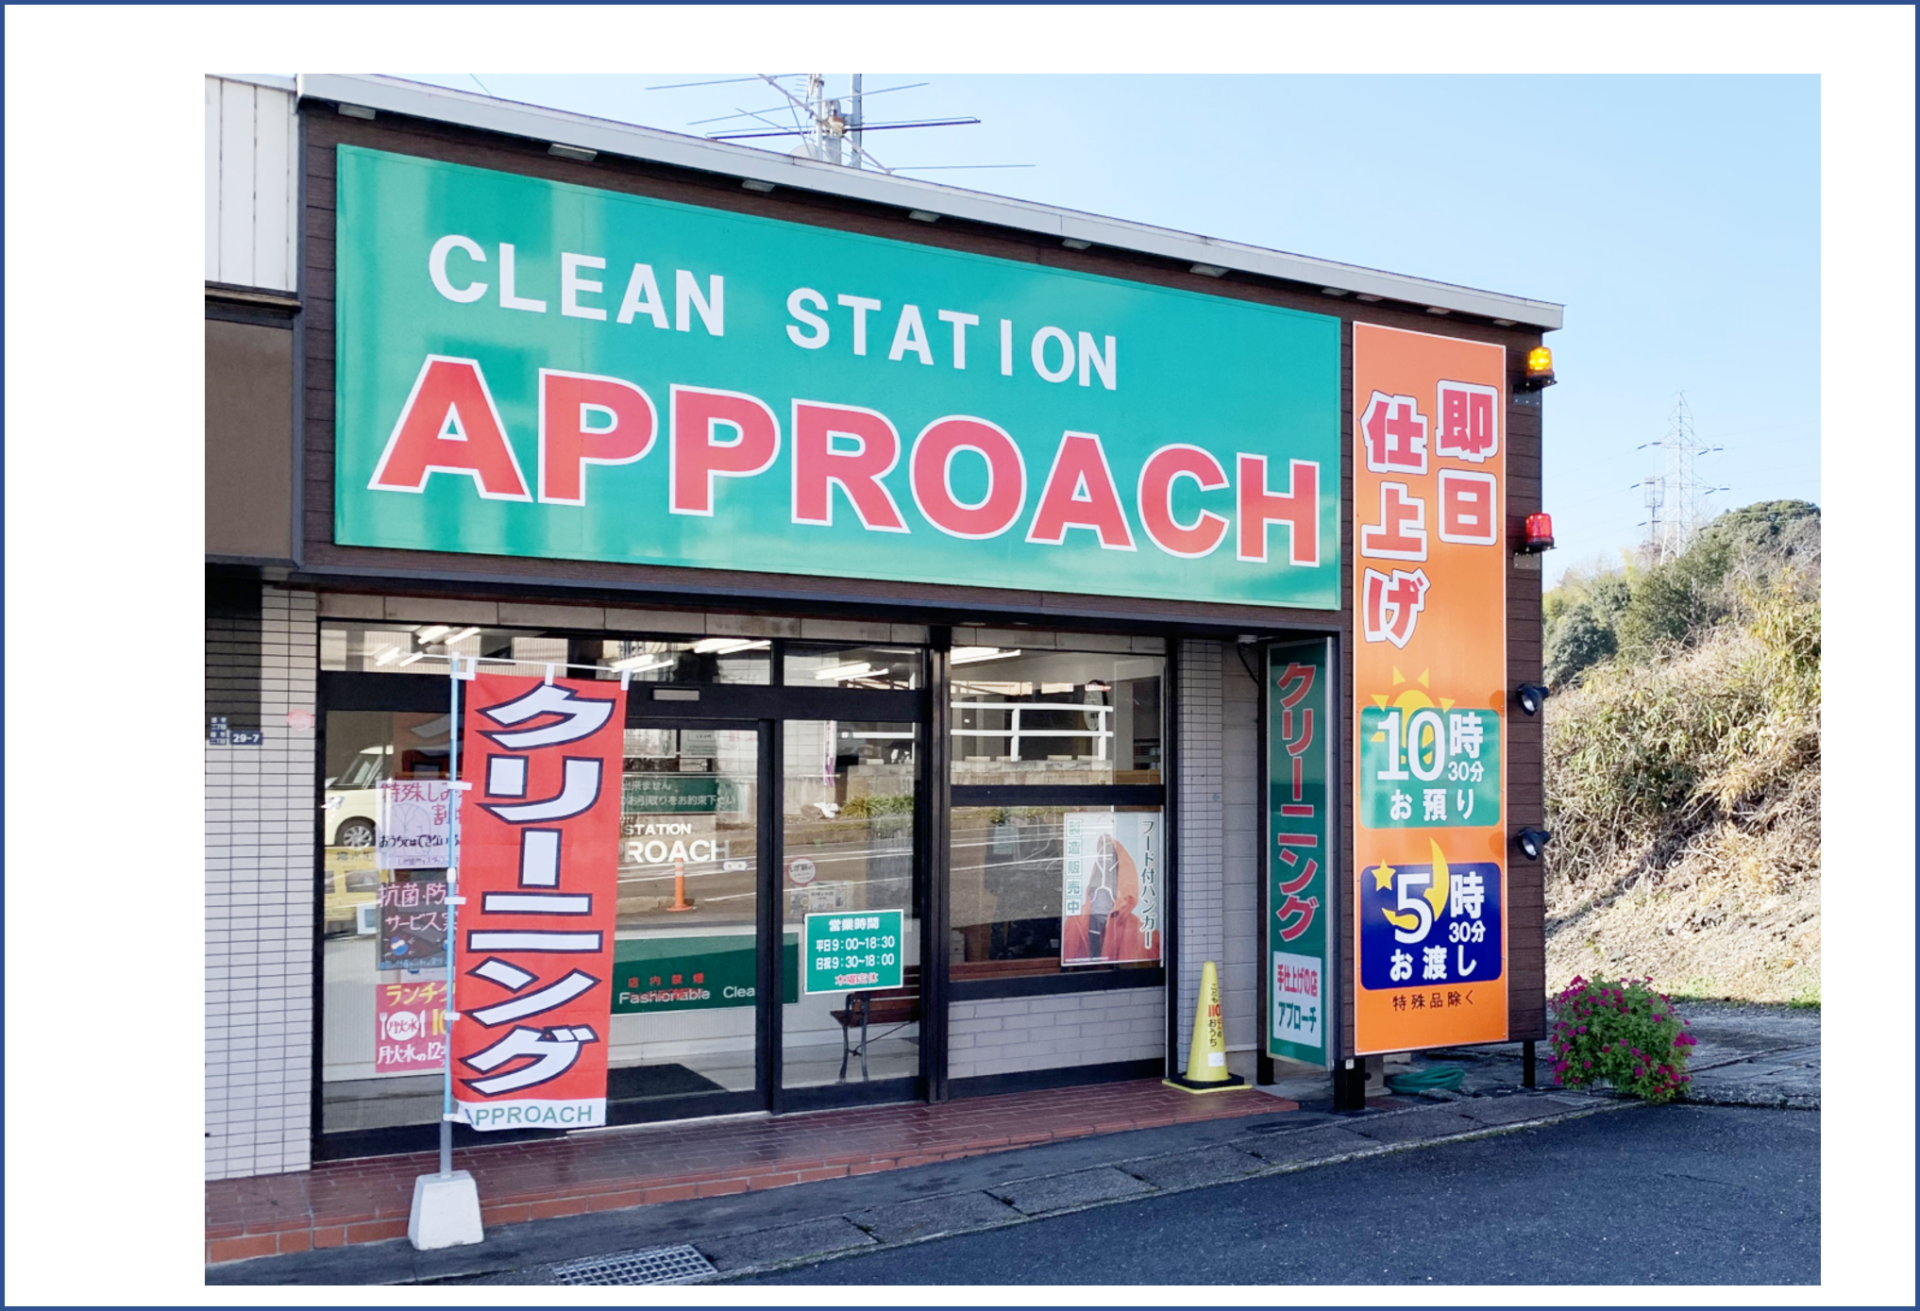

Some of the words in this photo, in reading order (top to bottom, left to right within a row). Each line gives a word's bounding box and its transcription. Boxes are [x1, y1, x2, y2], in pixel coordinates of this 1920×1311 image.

[428, 233, 725, 337] CLEAN
[785, 287, 1117, 390] STATION
[366, 353, 1321, 567] APPROACH
[1435, 379, 1499, 546] 即日
[1359, 389, 1431, 649] 仕上げ
[232, 733, 260, 743] 29-7
[1447, 760, 1486, 783] 30分
[1276, 662, 1320, 942] クリーニング
[1389, 788, 1475, 822] お預り
[625, 823, 692, 835] STATION
[1067, 820, 1082, 915] 製造販売中
[1140, 820, 1156, 949] フード付ハンガー
[458, 680, 617, 1097] クリーニング
[828, 917, 880, 932] 営業時間
[1447, 920, 1486, 943] 30分
[1276, 963, 1318, 998] 手仕上げの店
[1389, 944, 1478, 982] お渡し
[618, 988, 711, 1005] Fashionable
[1391, 990, 1475, 1012] 特殊品除く
